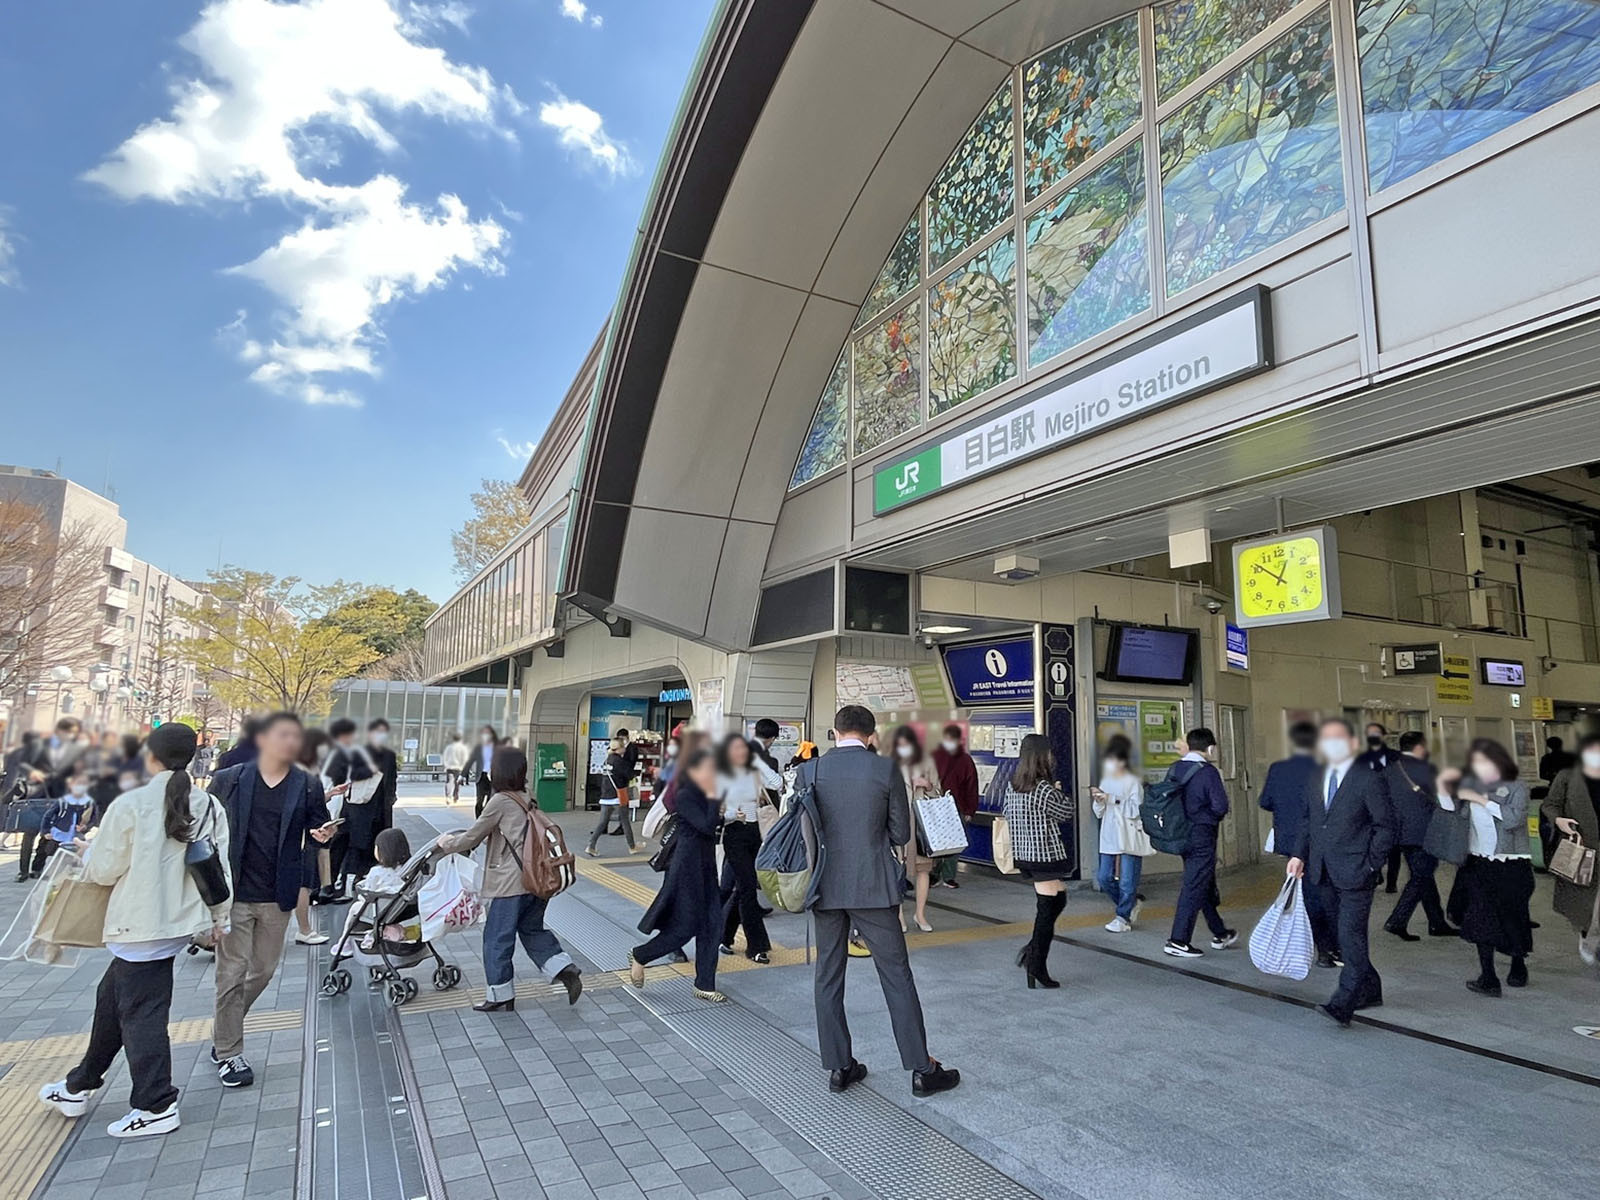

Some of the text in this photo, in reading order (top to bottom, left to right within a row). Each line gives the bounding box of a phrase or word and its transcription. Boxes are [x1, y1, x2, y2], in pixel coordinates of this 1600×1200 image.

[965, 355, 1210, 470] 目白駅 Mejiro Station
[896, 461, 919, 490] JR
[1273, 549, 1284, 558] 12
[1262, 555, 1271, 564] 11
[1299, 557, 1307, 565] 2
[1253, 565, 1263, 574] 10
[1306, 570, 1313, 579] 3
[1249, 579, 1256, 587] 9
[1301, 586, 1309, 594] 4
[1255, 592, 1263, 600] 8
[1291, 596, 1298, 605] 5
[1266, 600, 1273, 609] 7
[1278, 600, 1286, 609] 6
[979, 682, 992, 690] EAST
